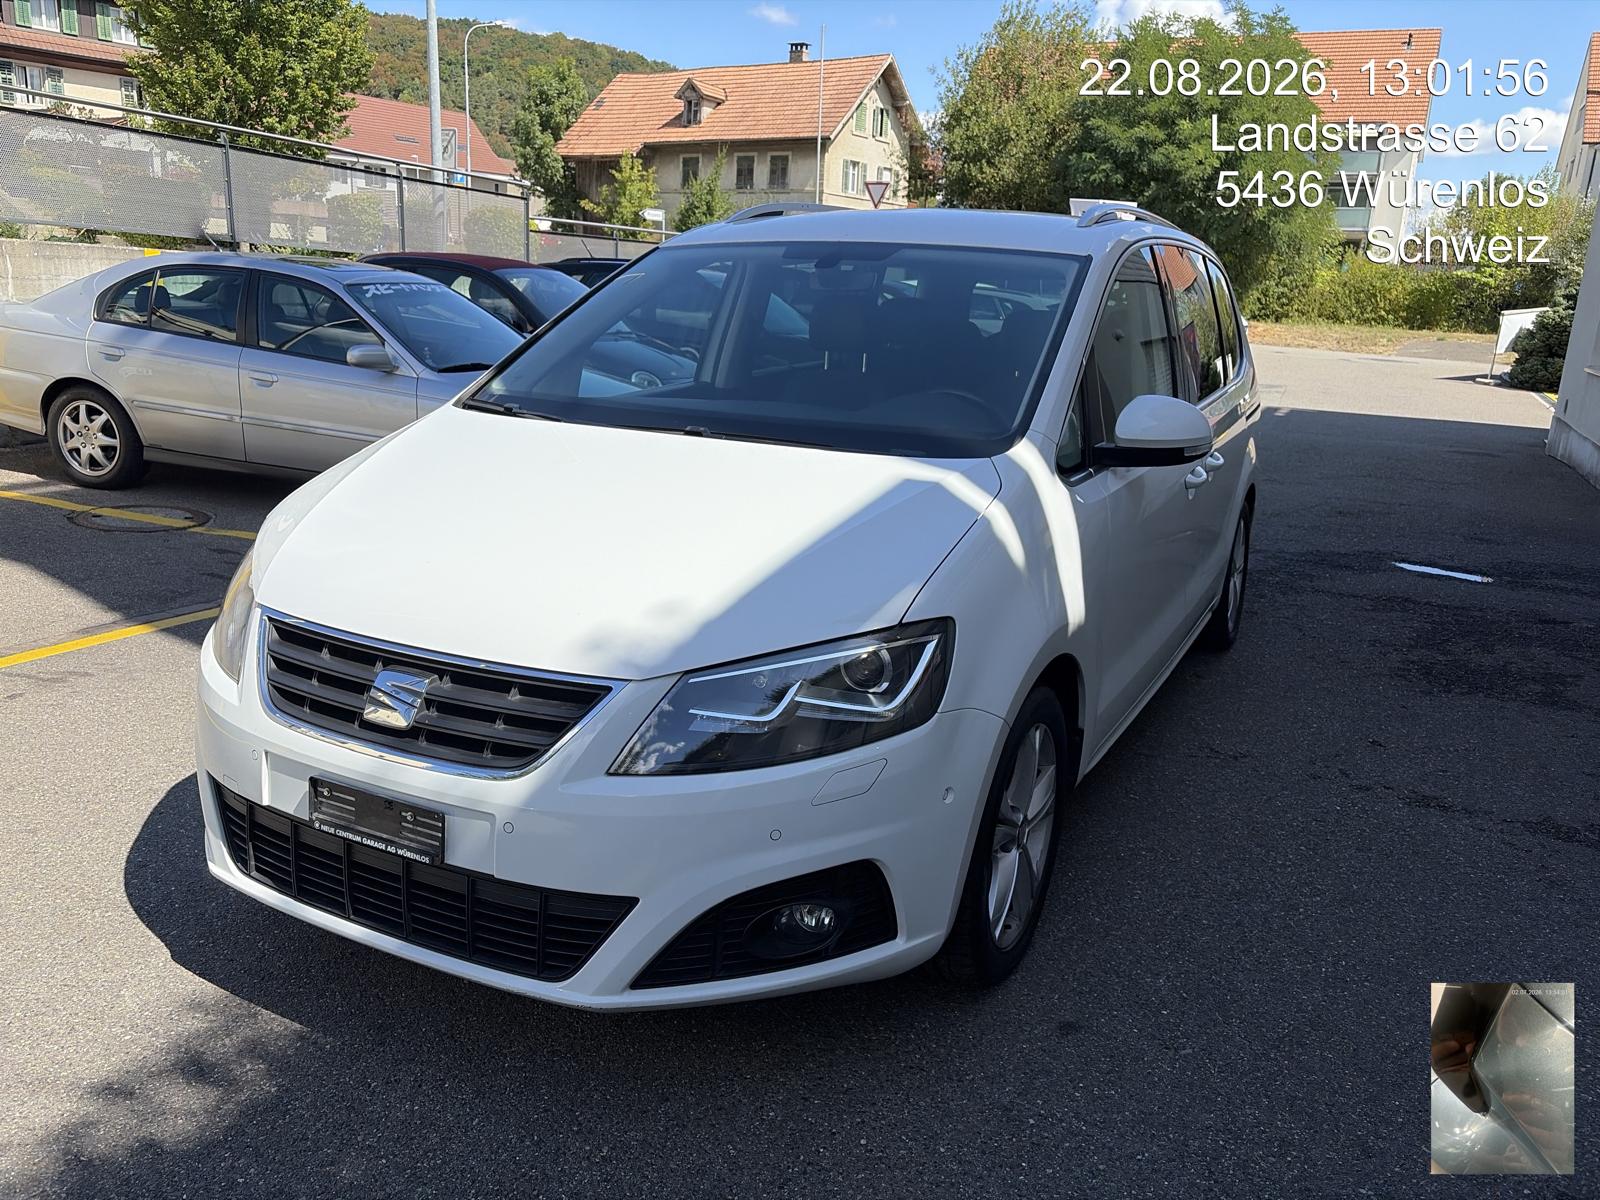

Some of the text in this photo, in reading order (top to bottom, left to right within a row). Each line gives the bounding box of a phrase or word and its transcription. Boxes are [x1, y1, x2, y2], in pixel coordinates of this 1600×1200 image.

[321, 825, 430, 864] NEUE CENTRUM GARAGE AG WÜRENLOS
